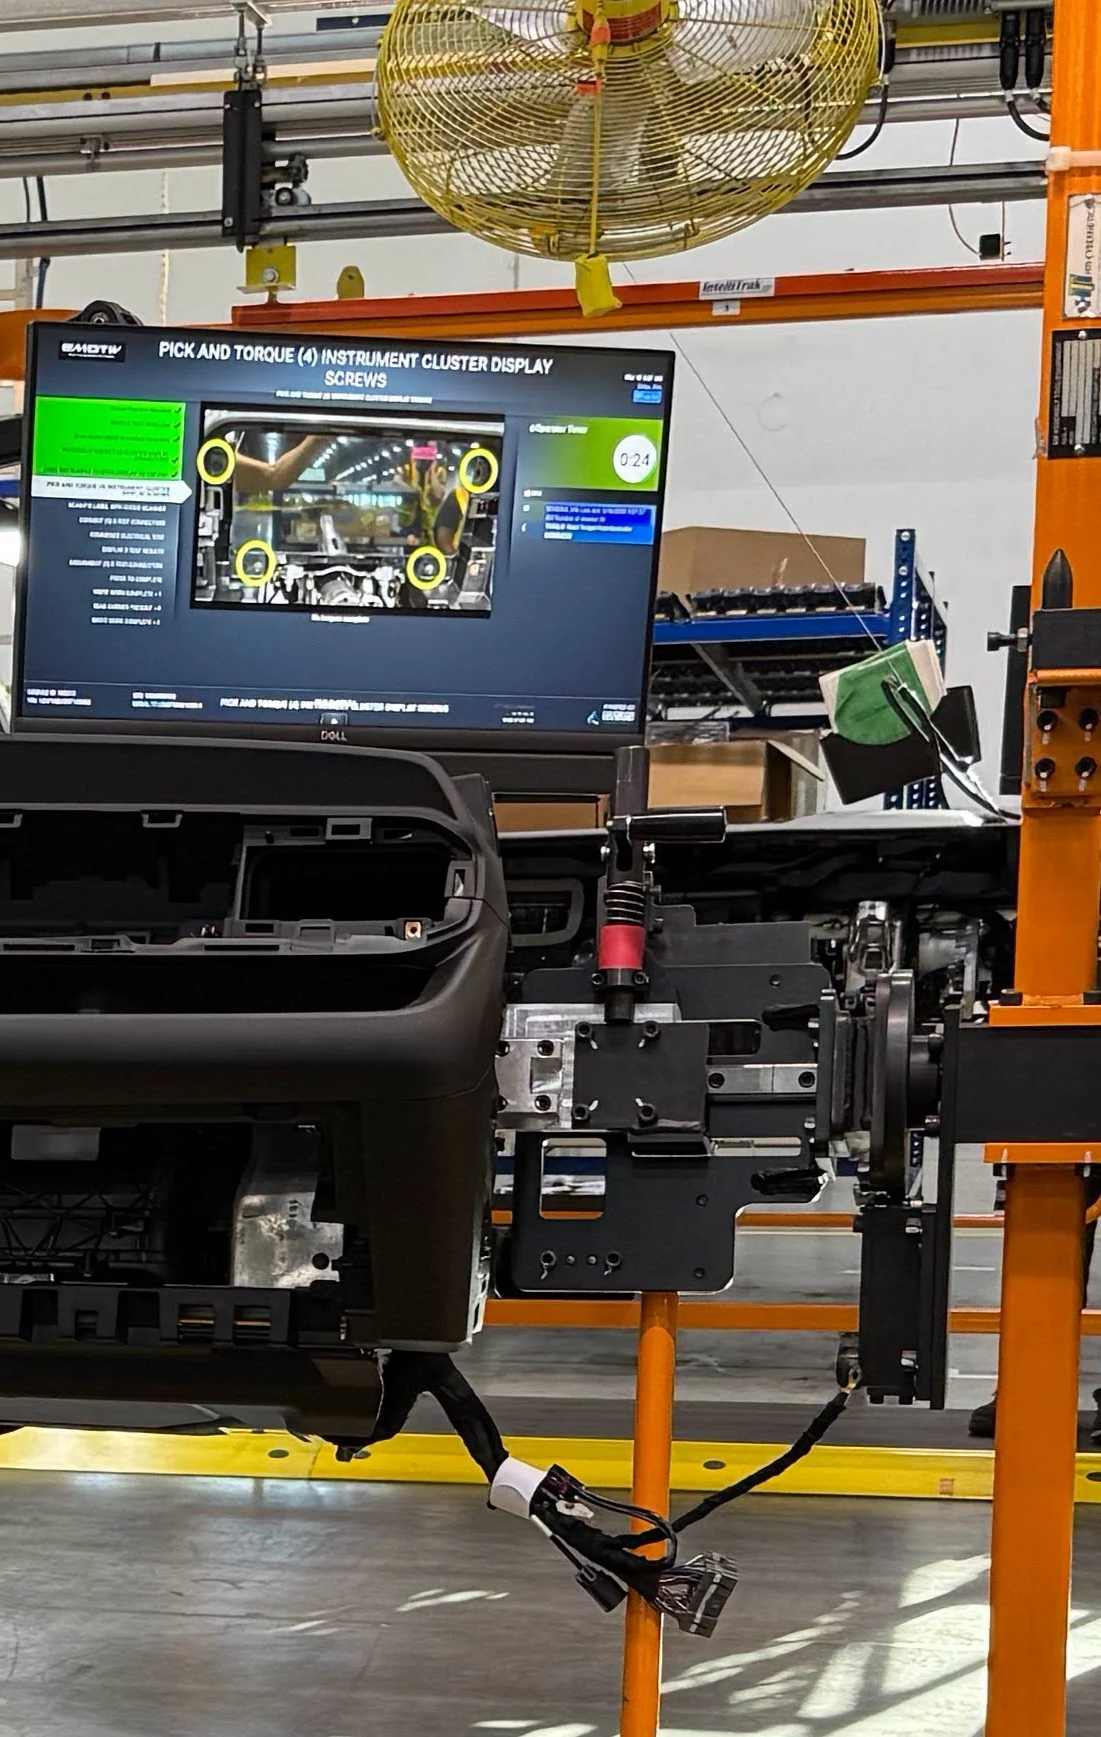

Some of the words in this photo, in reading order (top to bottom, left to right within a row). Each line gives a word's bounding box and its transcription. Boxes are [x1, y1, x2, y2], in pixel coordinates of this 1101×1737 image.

[159, 341, 198, 358] PICK
[199, 342, 230, 360] AND
[234, 344, 294, 363] TORQUE
[297, 346, 318, 367] (4)
[321, 348, 419, 369] INSTRUMENT
[421, 353, 487, 372] CLUSTER
[491, 356, 554, 375] DISPLAY
[324, 371, 387, 388] SCREWS
[620, 452, 650, 467] 0:24
